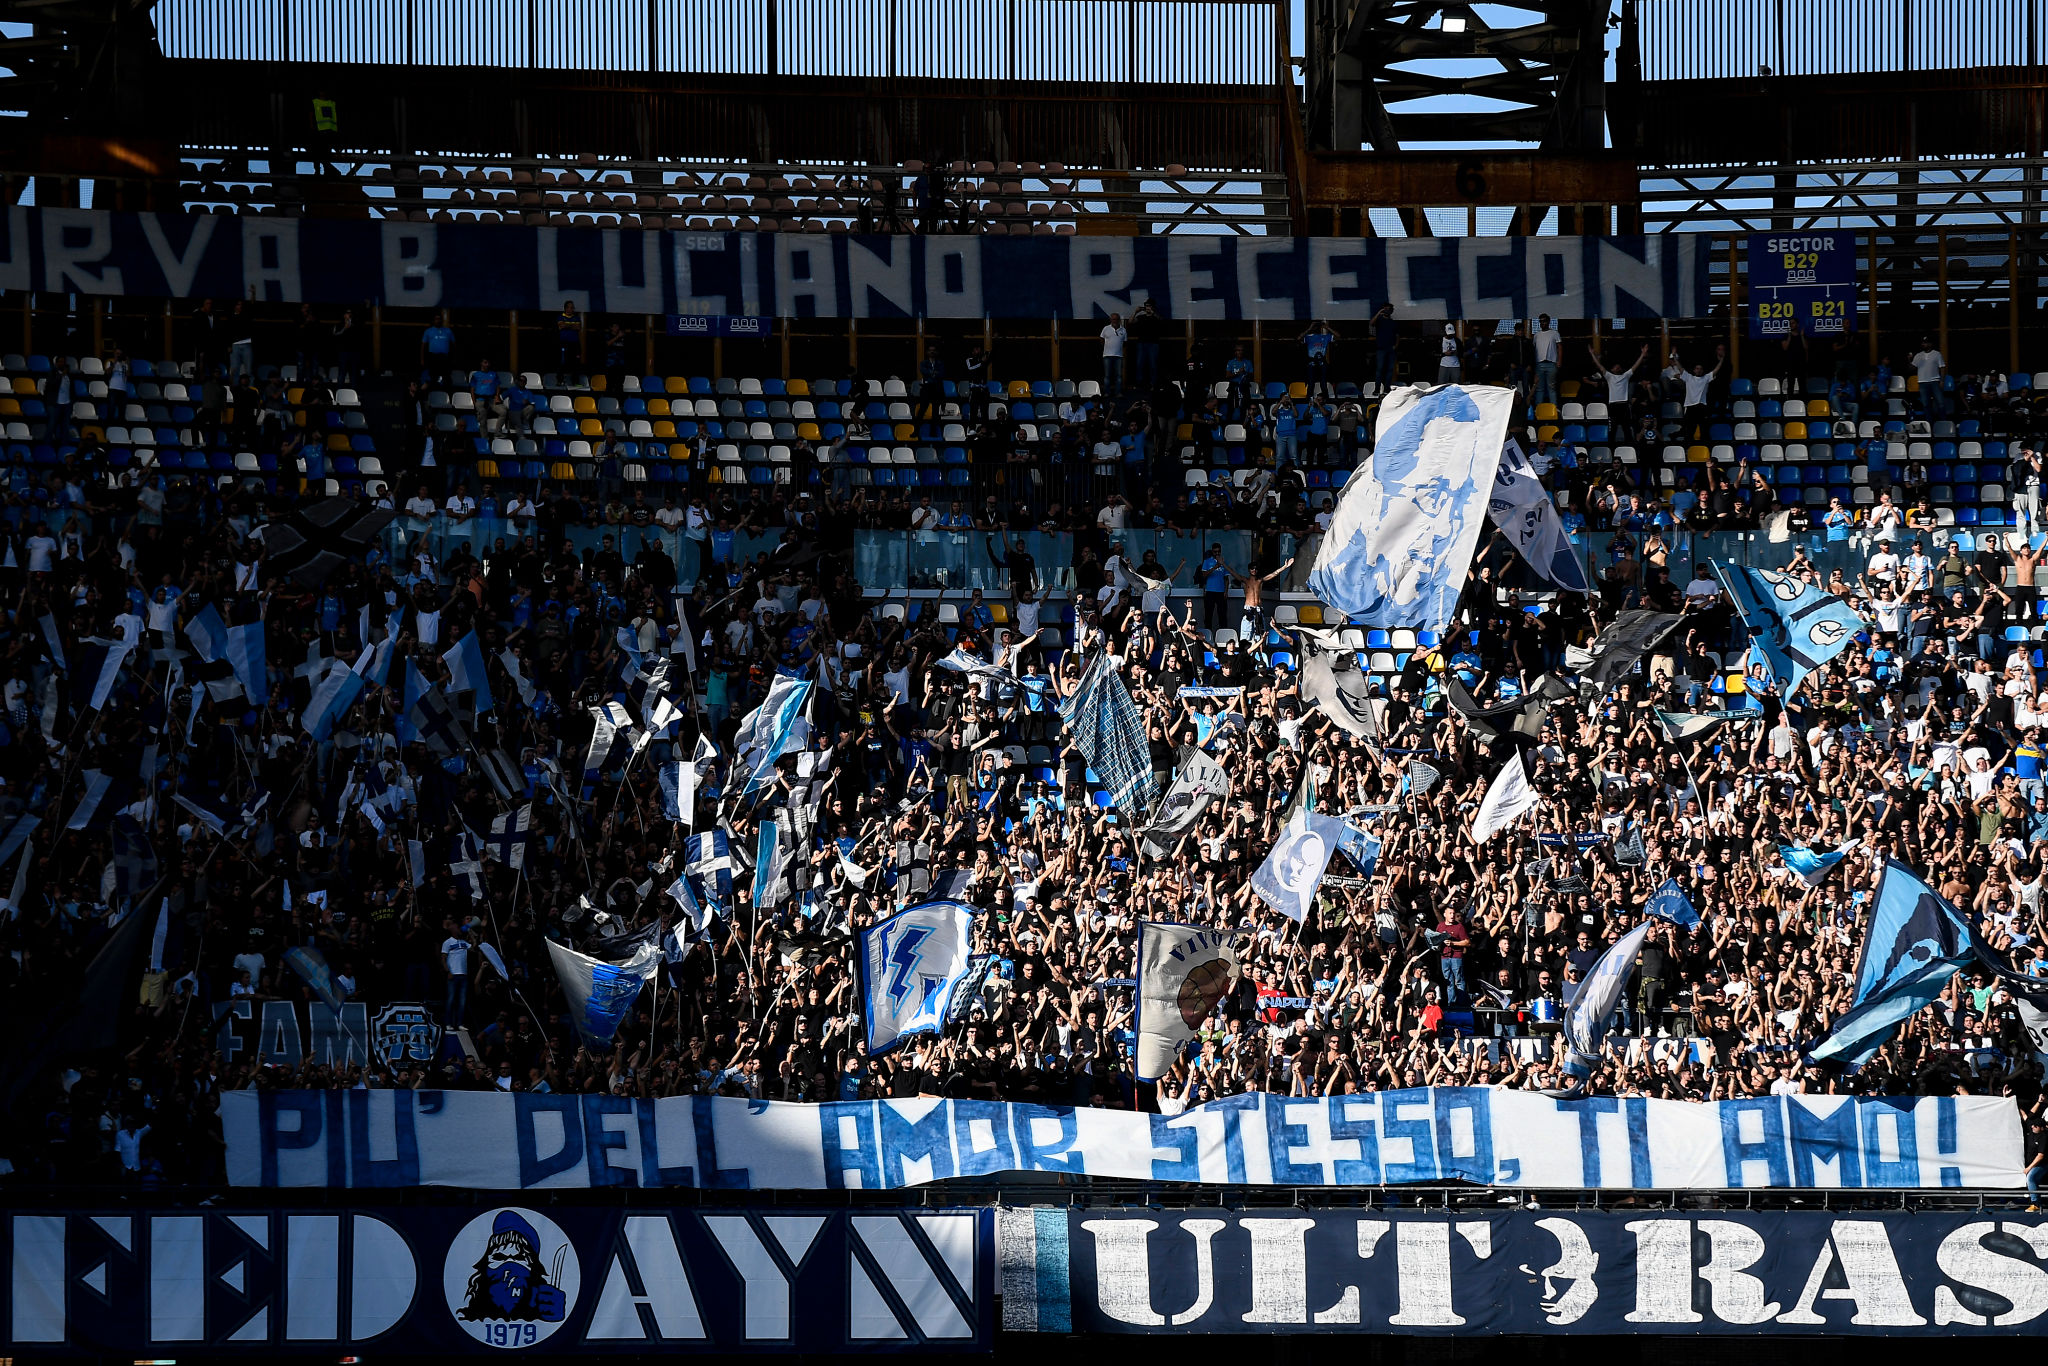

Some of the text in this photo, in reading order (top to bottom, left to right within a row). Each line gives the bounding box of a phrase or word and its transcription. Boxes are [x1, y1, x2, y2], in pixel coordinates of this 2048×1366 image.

[1455, 164, 1486, 198] 6
[686, 236, 751, 252] SECTR
[1767, 237, 1836, 253] SECTOR
[1783, 253, 1819, 269] B29
[381, 223, 443, 307] B
[537, 226, 983, 318] LUCIANO
[1759, 303, 1794, 318] B20
[1811, 301, 1845, 316] B21
[1556, 1097, 1652, 1188] TI
[485, 1323, 537, 1347] 1979
